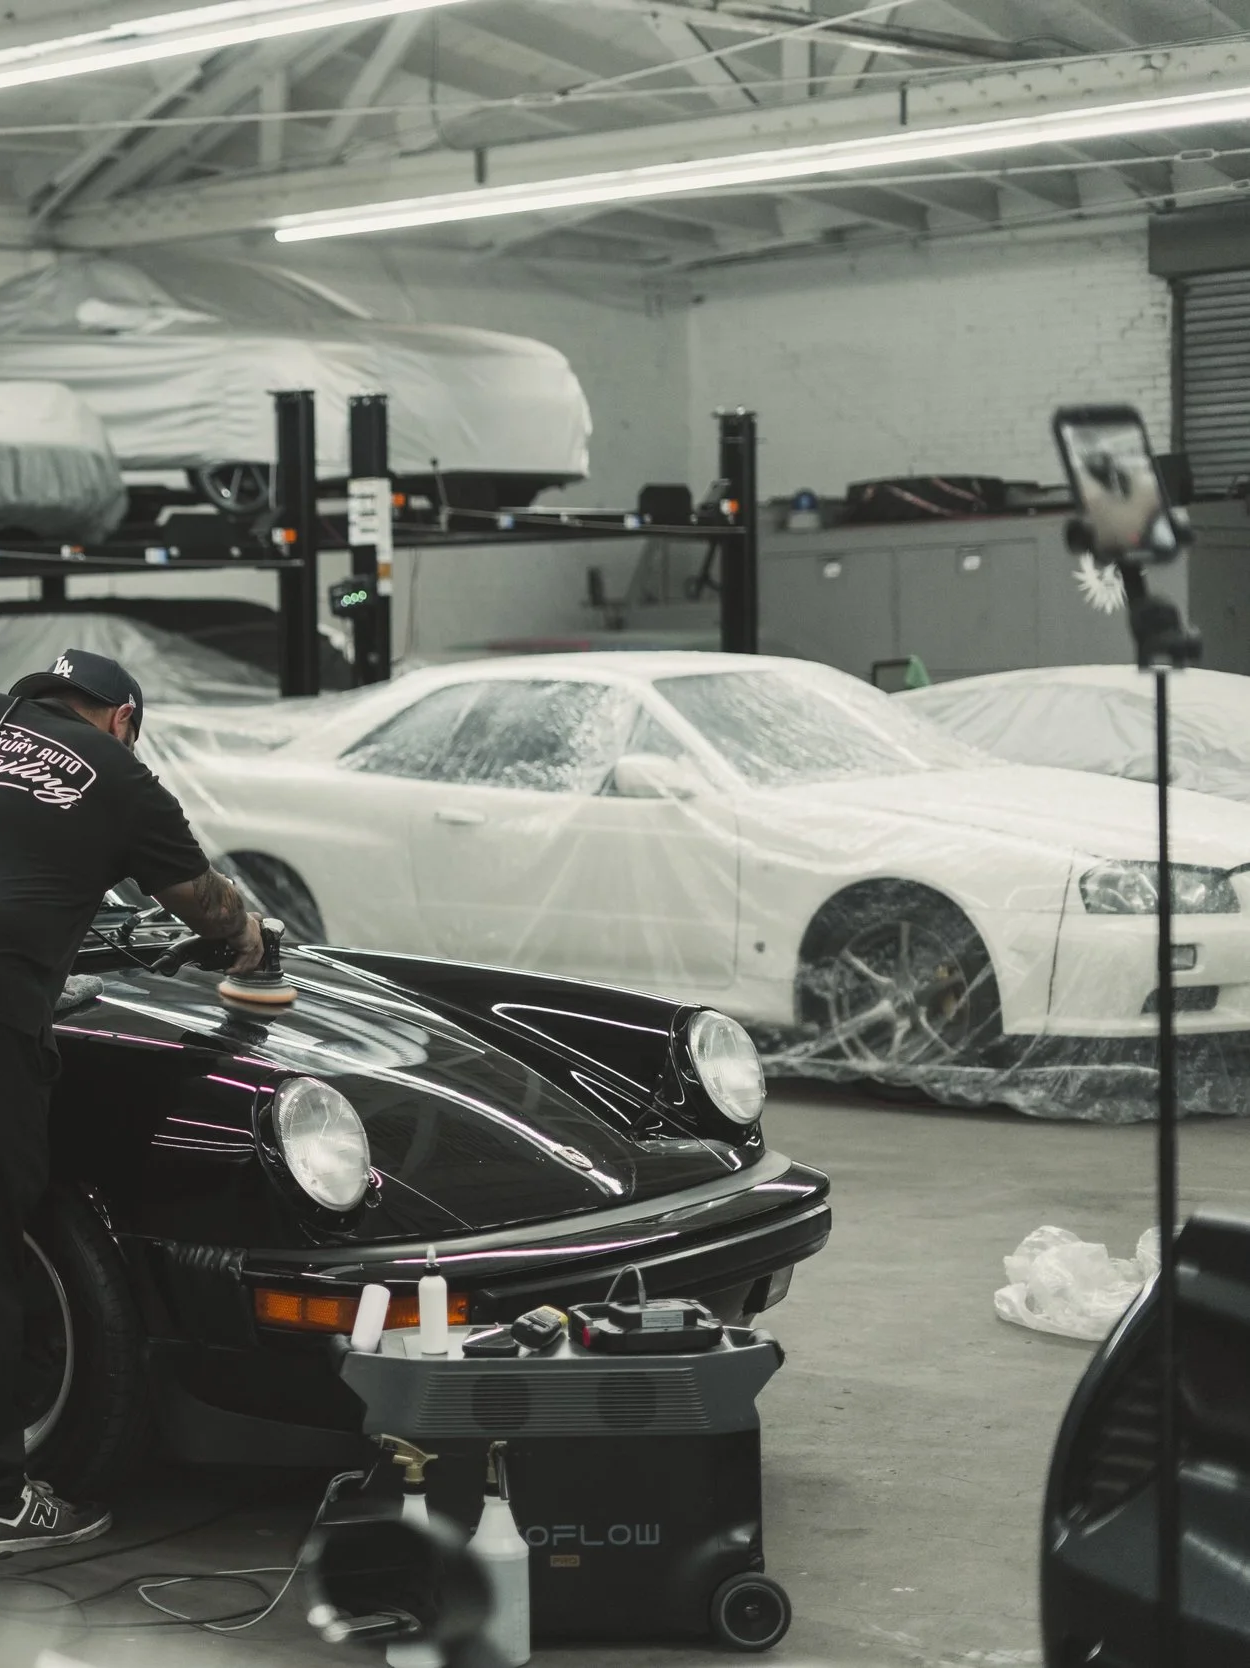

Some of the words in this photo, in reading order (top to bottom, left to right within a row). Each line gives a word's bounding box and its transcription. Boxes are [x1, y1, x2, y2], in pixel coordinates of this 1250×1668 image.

[52, 655, 74, 678] LA
[36, 748, 83, 775] AUTO
[29, 1502, 59, 1529] N
[470, 1523, 660, 1547] OFLOW
